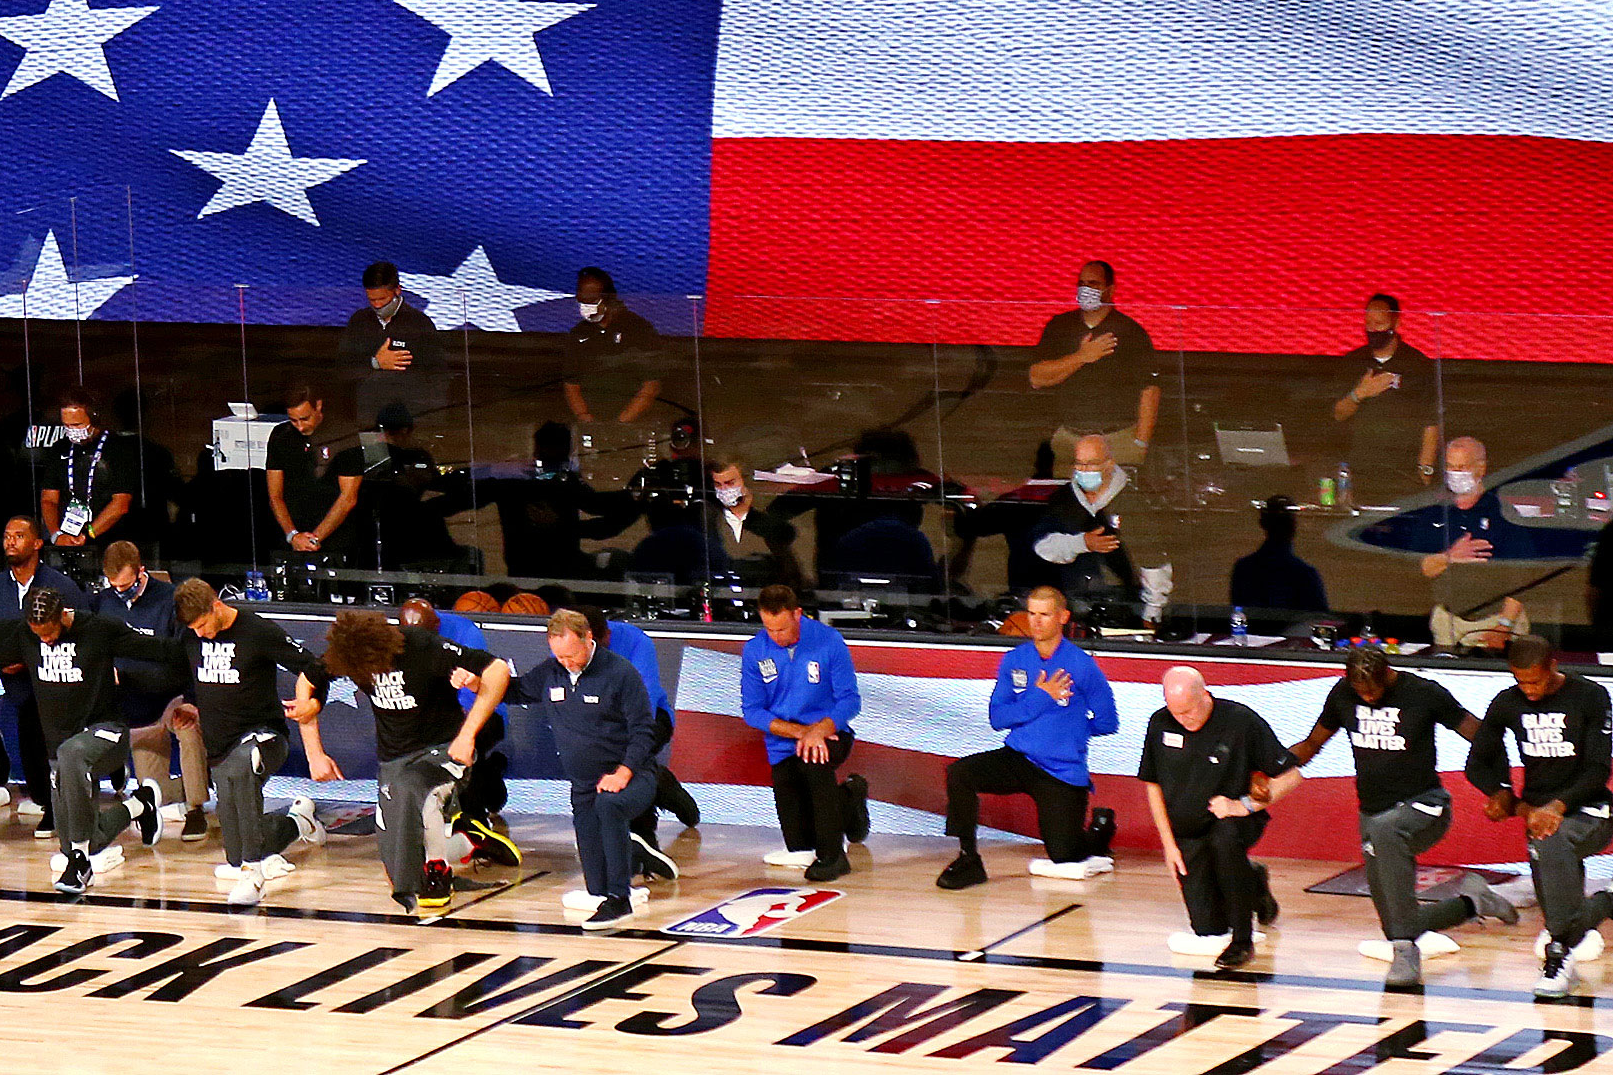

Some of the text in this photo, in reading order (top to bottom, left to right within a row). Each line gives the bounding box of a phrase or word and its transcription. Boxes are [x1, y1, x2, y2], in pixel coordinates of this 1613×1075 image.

[40, 642, 77, 657] BLACK
[201, 641, 236, 658] BLACK
[42, 655, 73, 669] LIVES
[204, 656, 232, 670] LIVES
[37, 666, 84, 683] MATTER
[197, 667, 241, 684] MATTER
[370, 694, 418, 710] MATTER
[1355, 704, 1401, 723] BLACK
[1521, 712, 1567, 729] BLACK
[1358, 719, 1396, 735] LIVES
[1527, 727, 1564, 743] LIVES
[1350, 731, 1406, 751] MATTER
[1520, 741, 1577, 758] MATTER
[676, 922, 732, 933] NBA
[243, 946, 818, 1036] LIVES
